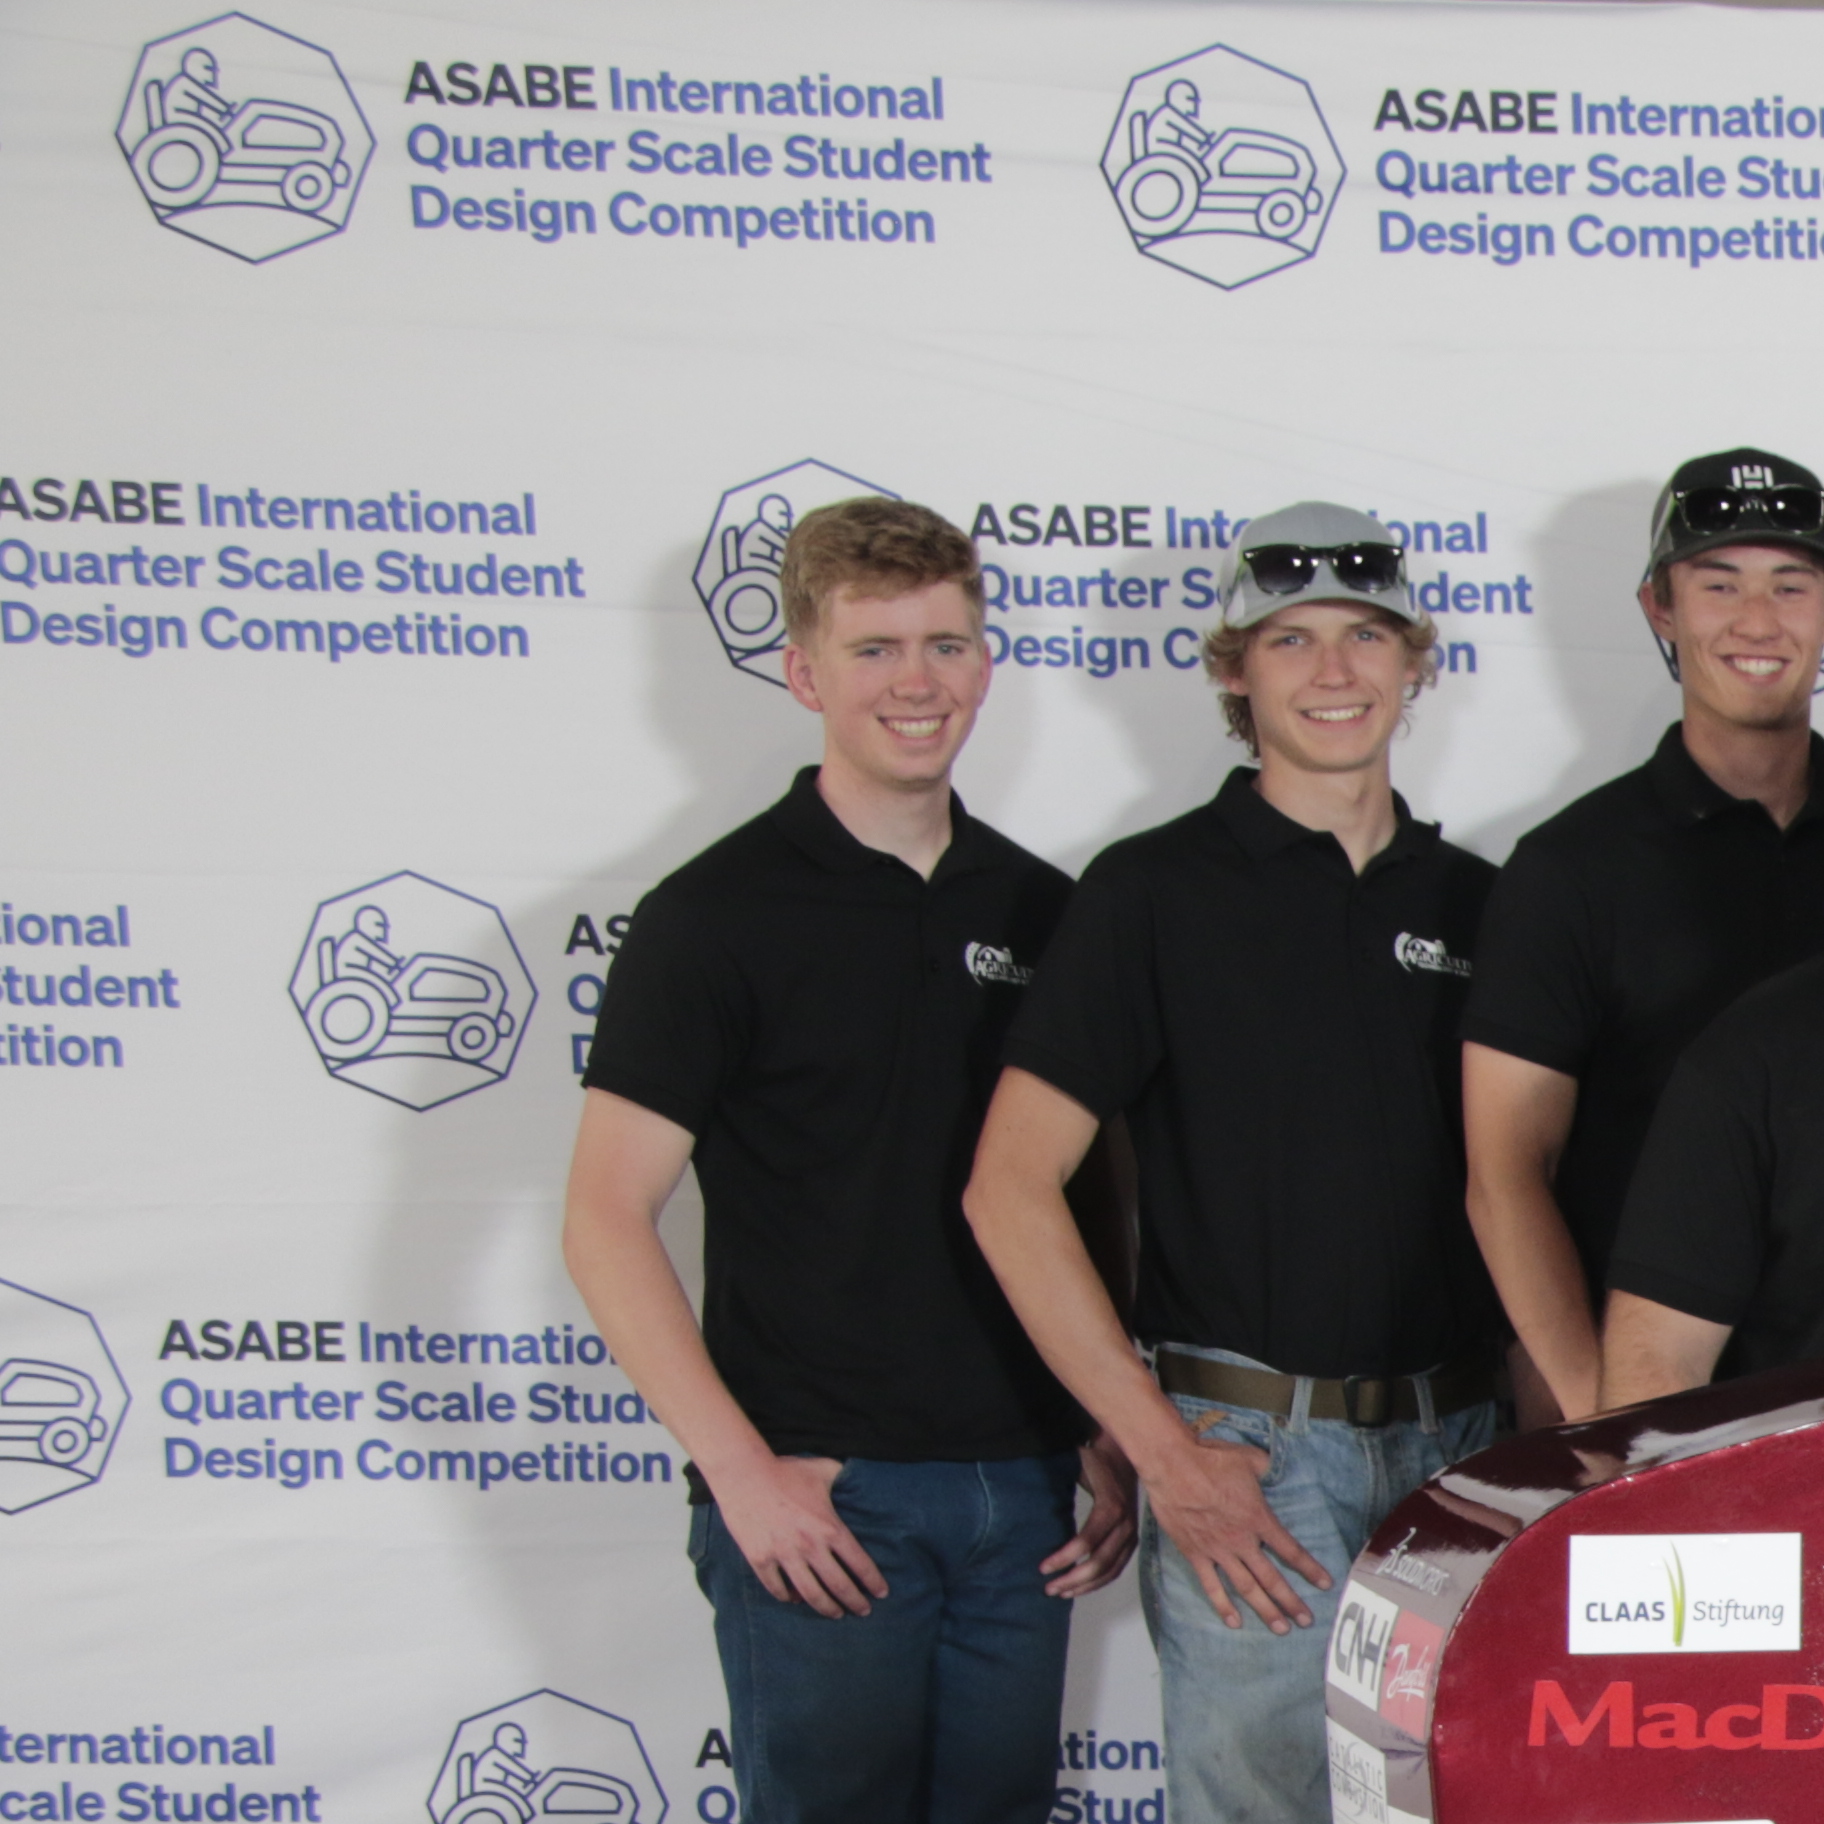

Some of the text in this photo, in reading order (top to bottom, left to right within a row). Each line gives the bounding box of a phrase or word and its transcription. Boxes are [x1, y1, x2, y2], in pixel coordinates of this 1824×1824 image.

[404, 61, 943, 119] ASABE International
[407, 123, 991, 182] Quarter Scale Student
[411, 185, 934, 248] Design Competition
[0, 477, 535, 535] ASABE International
[0, 539, 585, 597] Quarter Scale Student
[0, 601, 528, 662] Design Competition
[158, 1319, 617, 1366] ASABE Internatio
[161, 1378, 662, 1425] Quarter Scale Stud
[164, 1437, 672, 1491] Design Competition
[1585, 1598, 1784, 1627] CLAAS Stiftung
[1335, 1601, 1389, 1692] CNH
